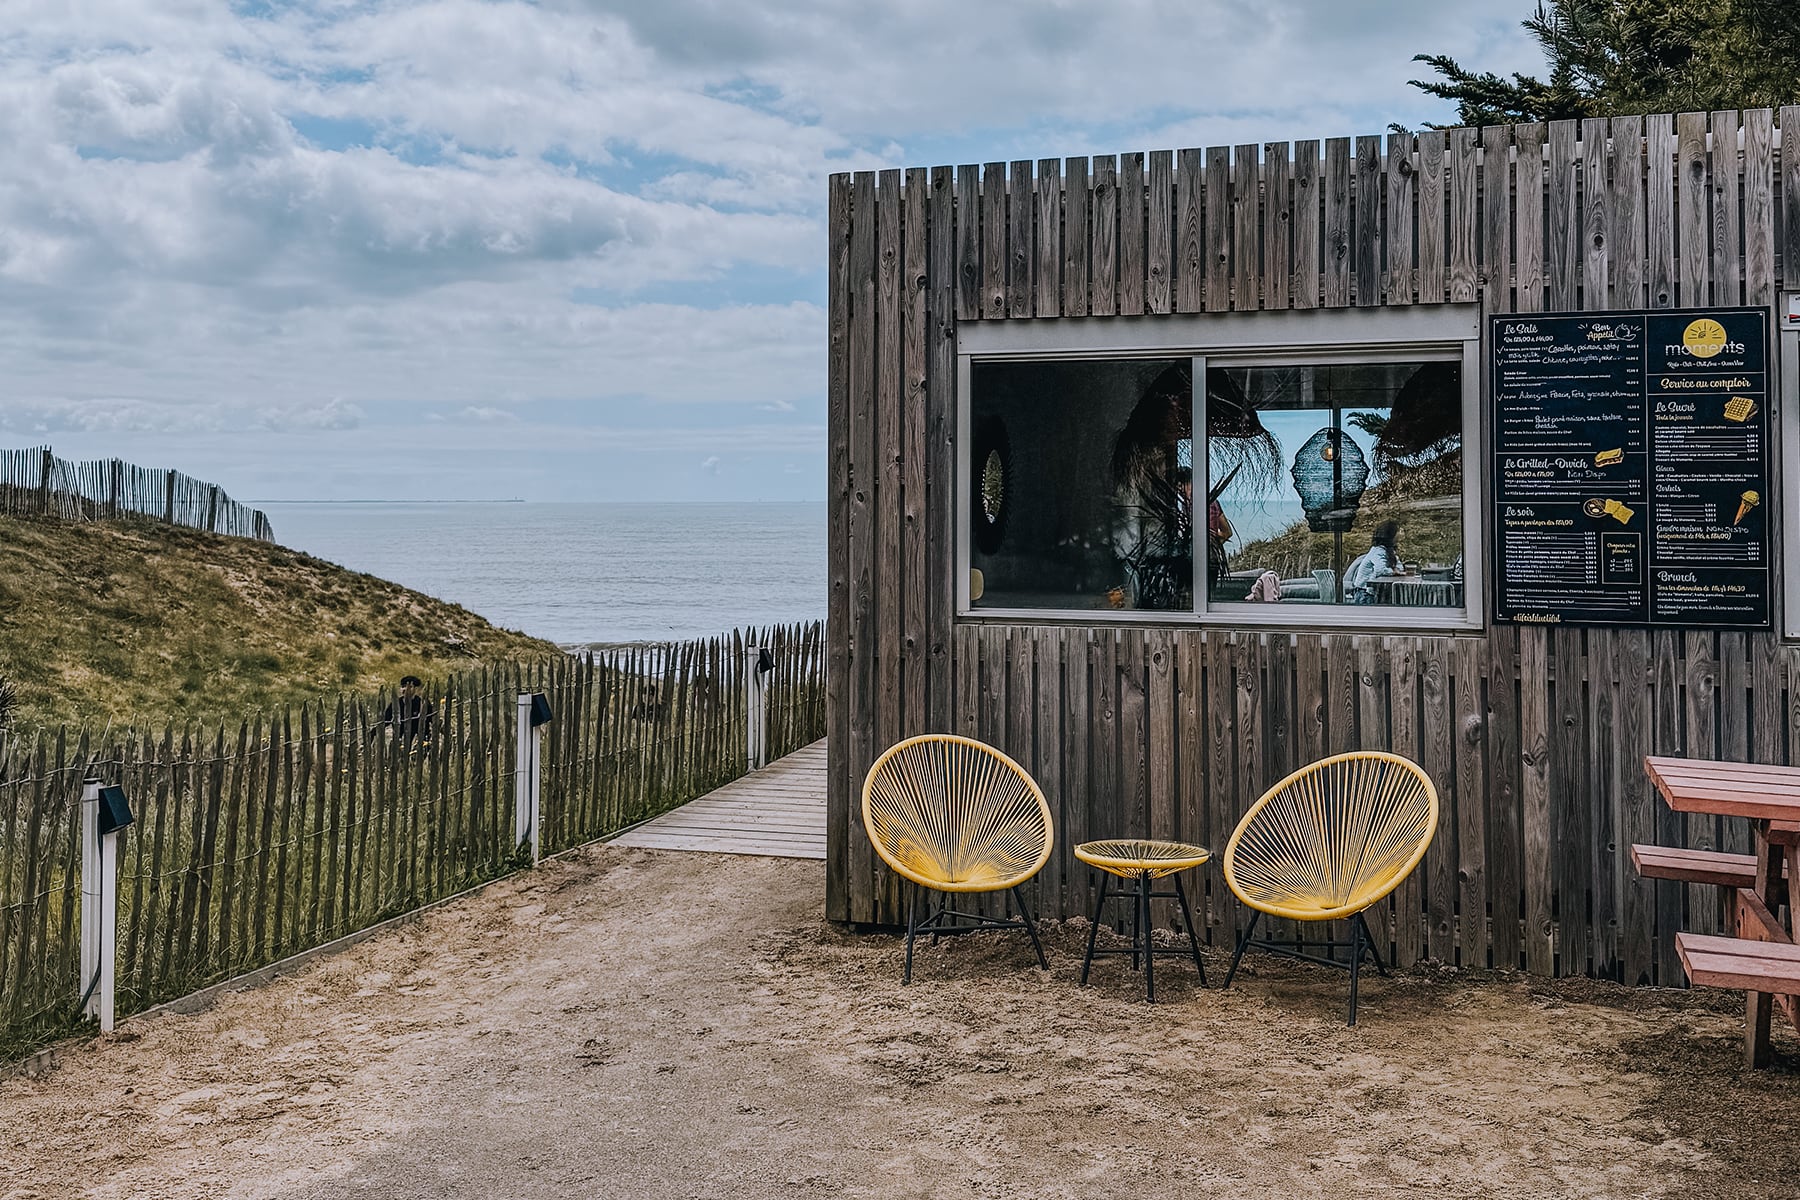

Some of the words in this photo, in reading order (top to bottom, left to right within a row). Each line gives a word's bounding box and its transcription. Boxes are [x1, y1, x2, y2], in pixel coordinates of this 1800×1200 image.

[1504, 324, 1516, 334] Le
[1516, 324, 1538, 334] Salé
[1586, 330, 1615, 340] Appétit
[1665, 341, 1745, 355] moments
[1660, 378, 1695, 389] Service
[1710, 377, 1751, 391] comptoir
[1654, 402, 1667, 412] Le
[1667, 402, 1696, 412] Sucré
[1504, 459, 1516, 469] Le
[1517, 458, 1588, 469] Grilled-Dwich
[1504, 507, 1517, 517] Le
[1517, 507, 1535, 516] soir
[1657, 570, 1697, 582] Brunch
